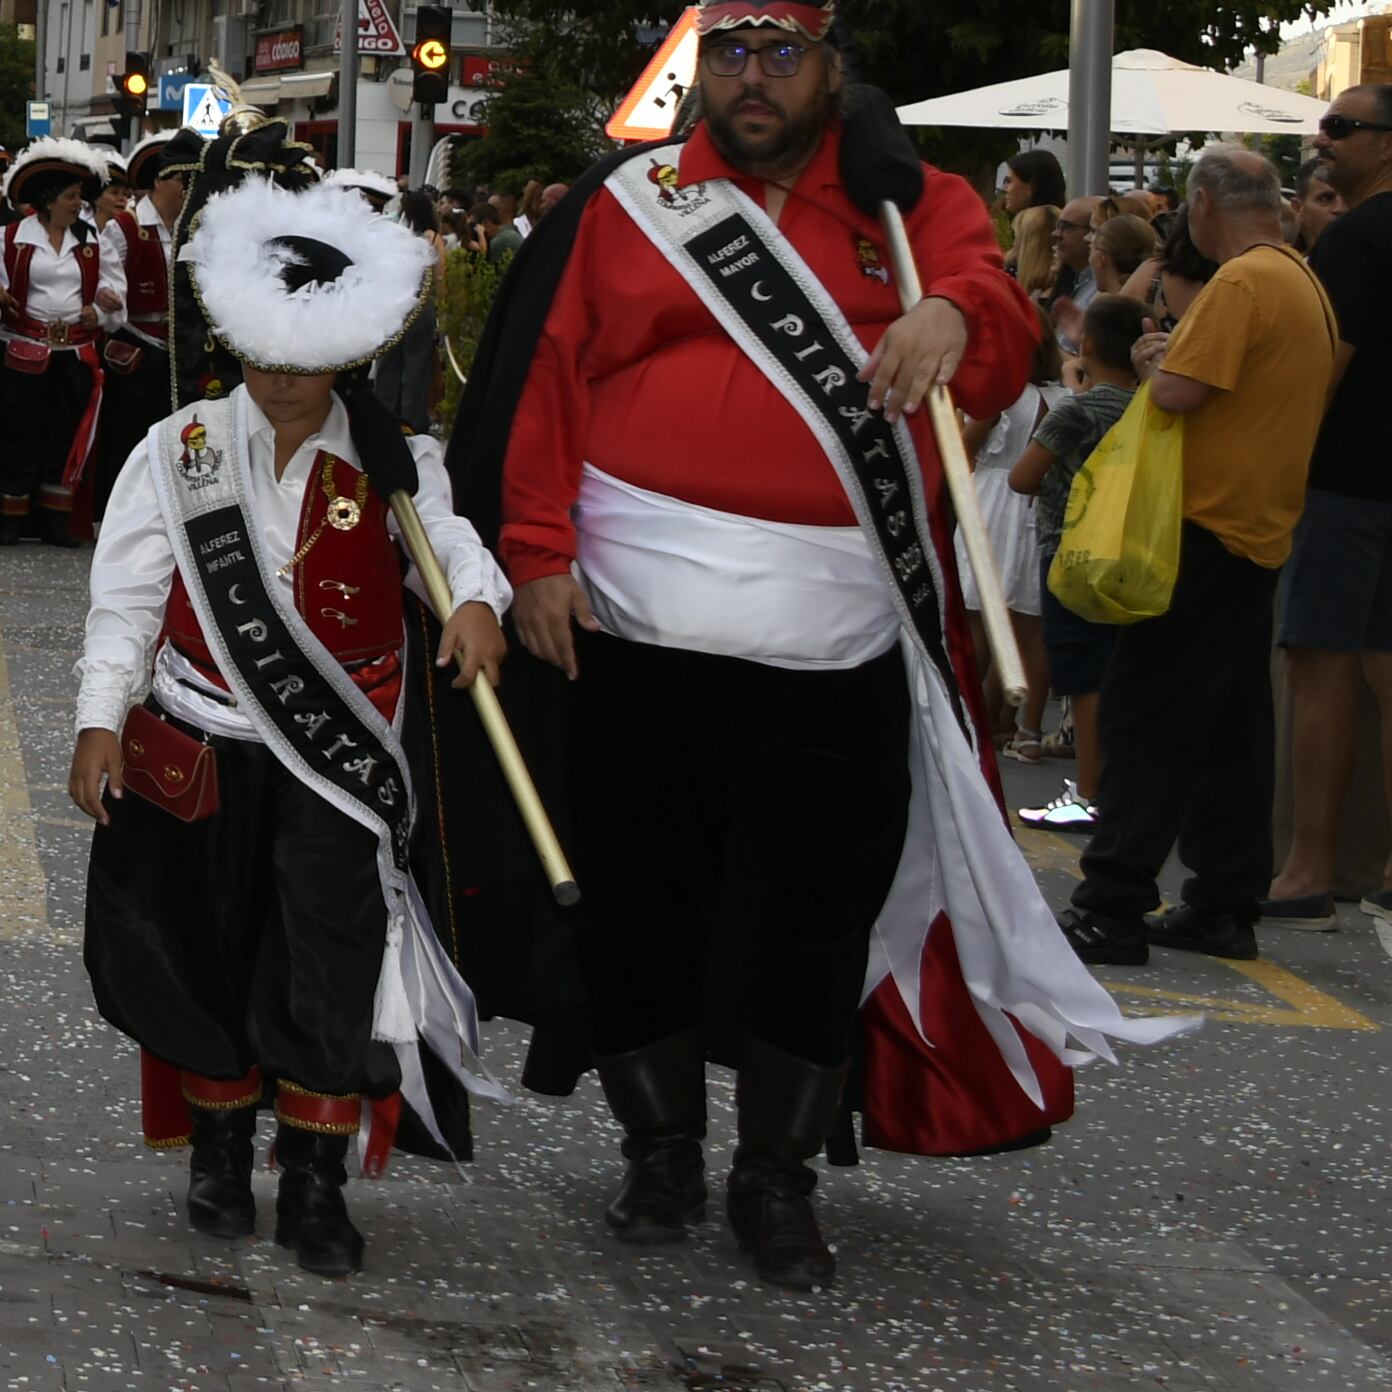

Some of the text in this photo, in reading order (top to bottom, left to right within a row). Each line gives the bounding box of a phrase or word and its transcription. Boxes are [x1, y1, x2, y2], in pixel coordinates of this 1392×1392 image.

[707, 234, 750, 265] ALFEREZ
[719, 252, 760, 278] MAYOR
[769, 313, 907, 538] PIRATAS
[186, 477, 220, 492] VILLENA
[199, 530, 241, 556] ALFEREZ
[205, 550, 246, 574] INFANTIL
[236, 617, 400, 806] PIRATAS
